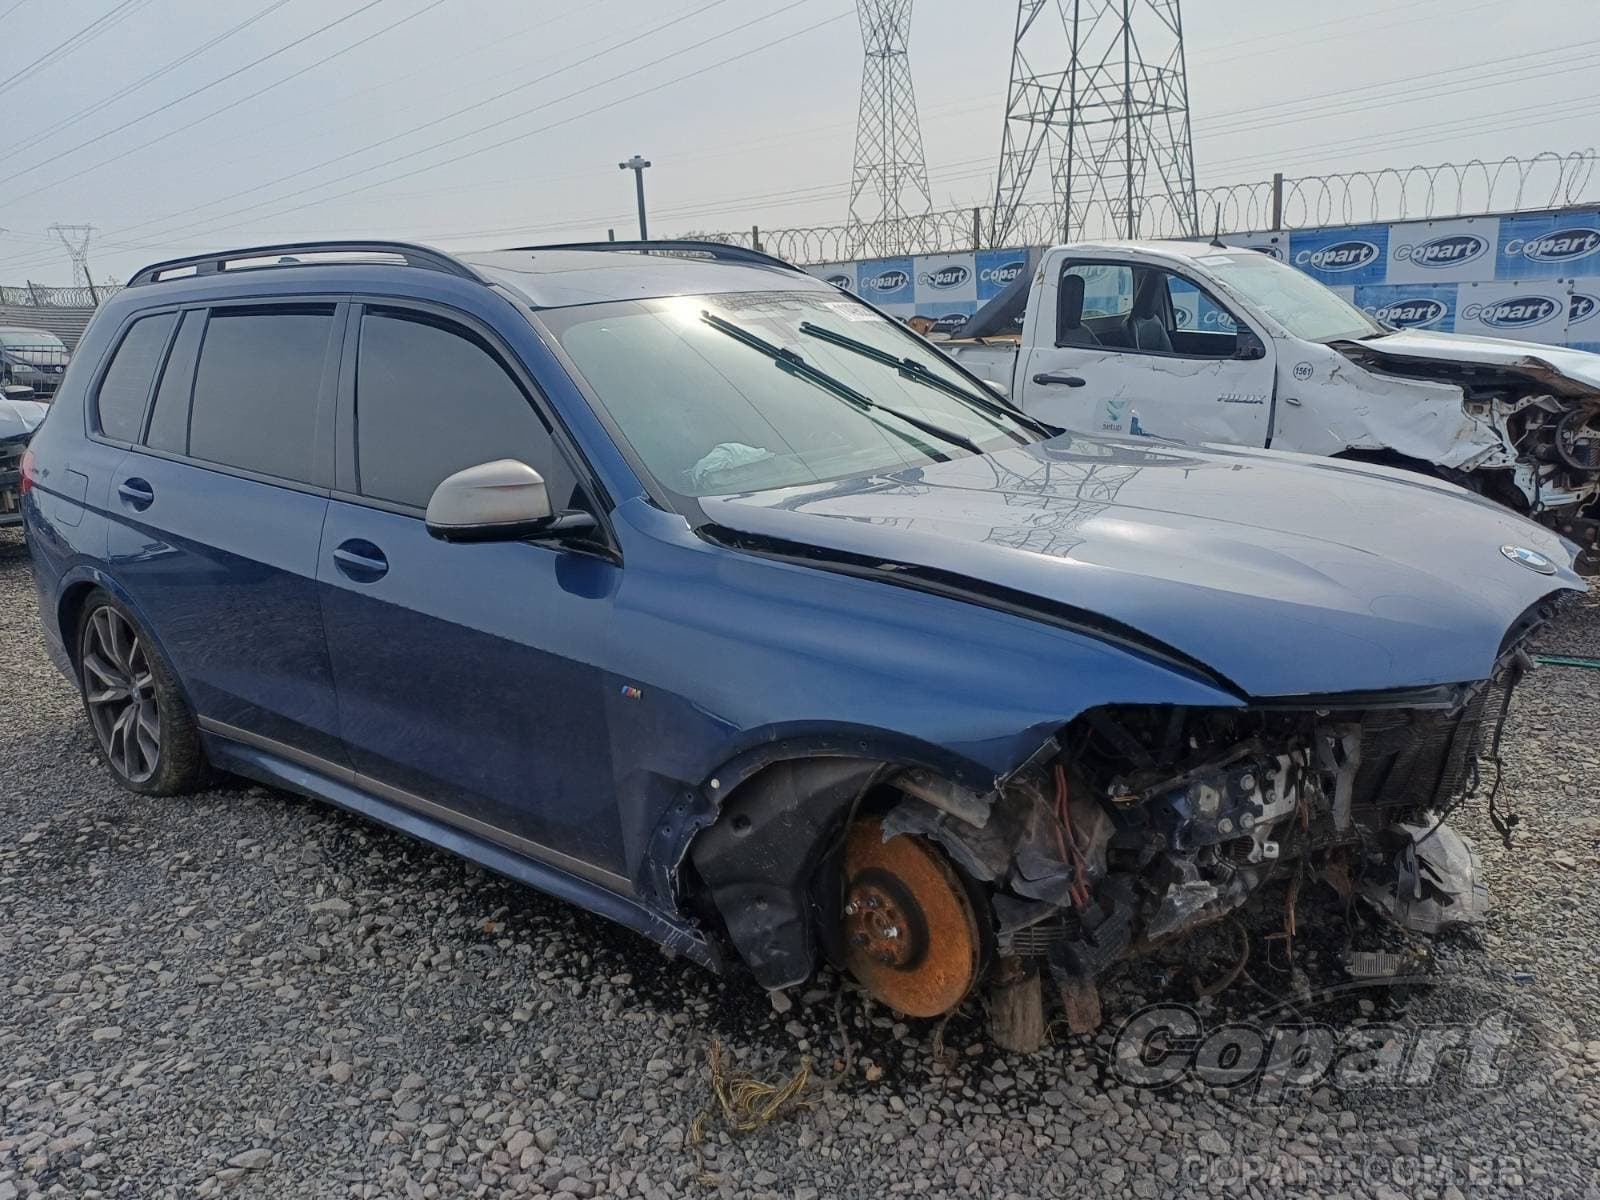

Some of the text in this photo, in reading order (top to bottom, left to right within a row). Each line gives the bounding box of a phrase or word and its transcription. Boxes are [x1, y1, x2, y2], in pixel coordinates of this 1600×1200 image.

[1394, 240, 1477, 262] Copart
[1504, 233, 1596, 257] Copart
[1295, 246, 1369, 266] Copart
[860, 272, 905, 289] Copart
[919, 270, 965, 286] Copart
[1462, 302, 1550, 321] Copart
[1295, 366, 1311, 376] 1561
[1102, 423, 1122, 432] setup
